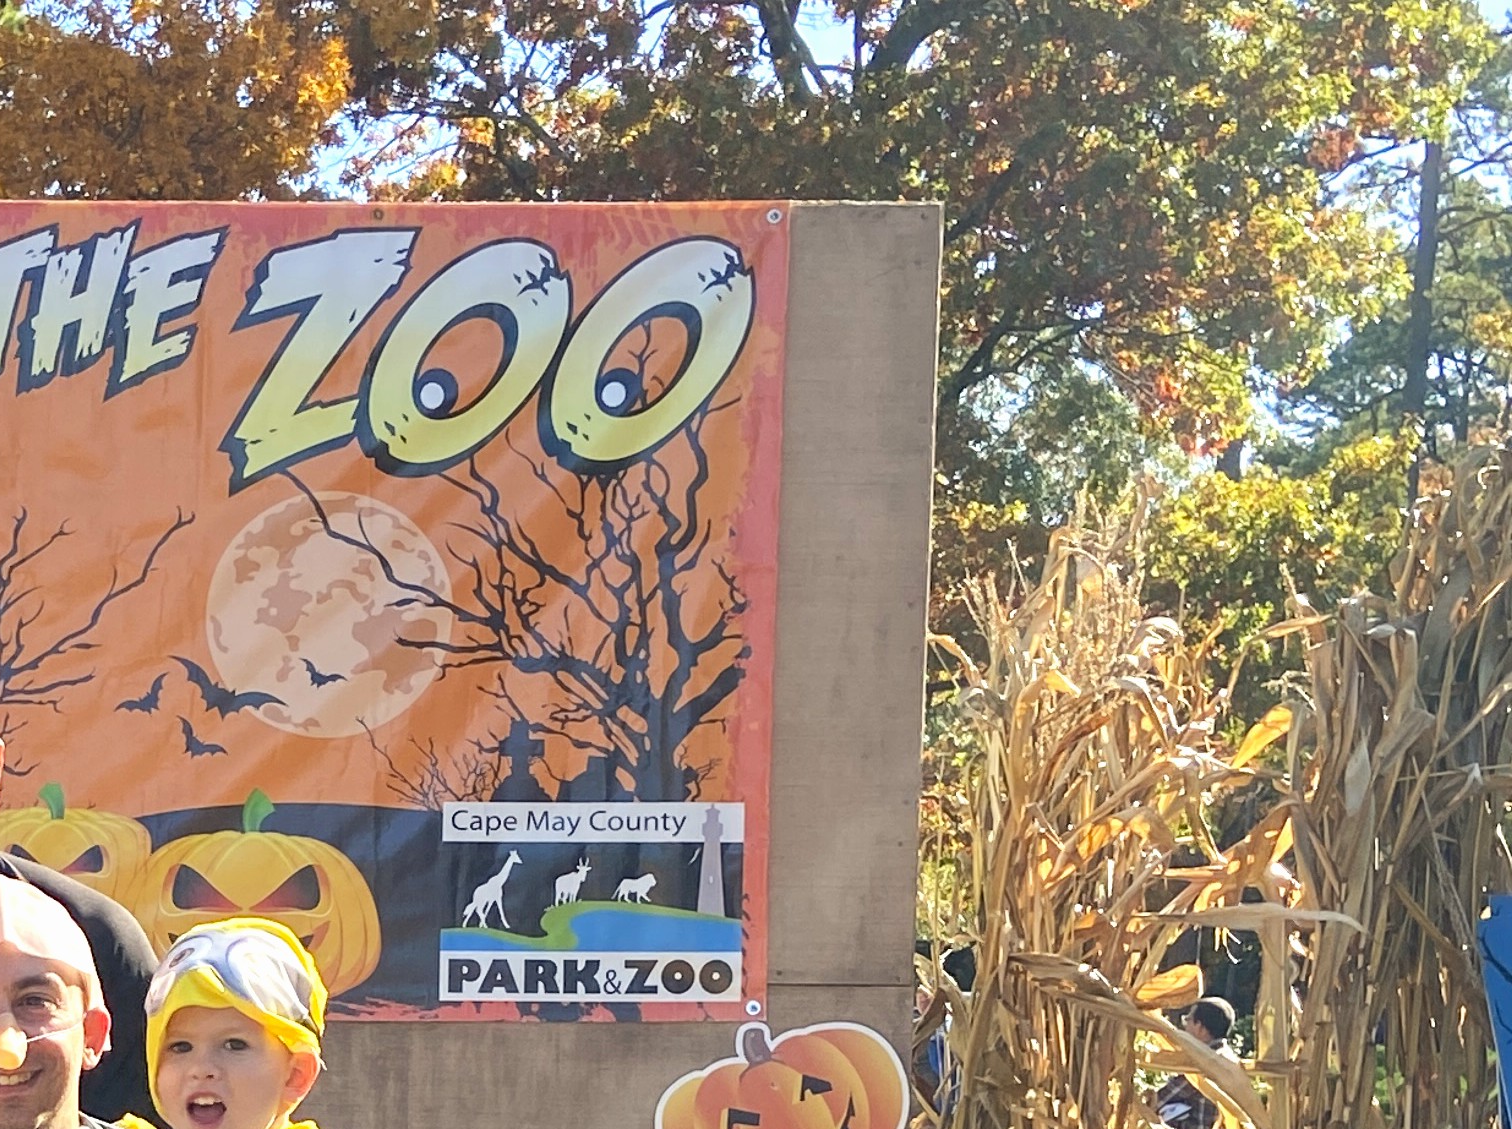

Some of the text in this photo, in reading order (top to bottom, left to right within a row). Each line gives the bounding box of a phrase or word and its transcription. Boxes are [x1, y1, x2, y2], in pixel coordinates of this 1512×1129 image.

[218, 227, 756, 496] ZOO
[451, 810, 687, 837] Cape May County
[447, 958, 734, 996] PARK&ZOO
